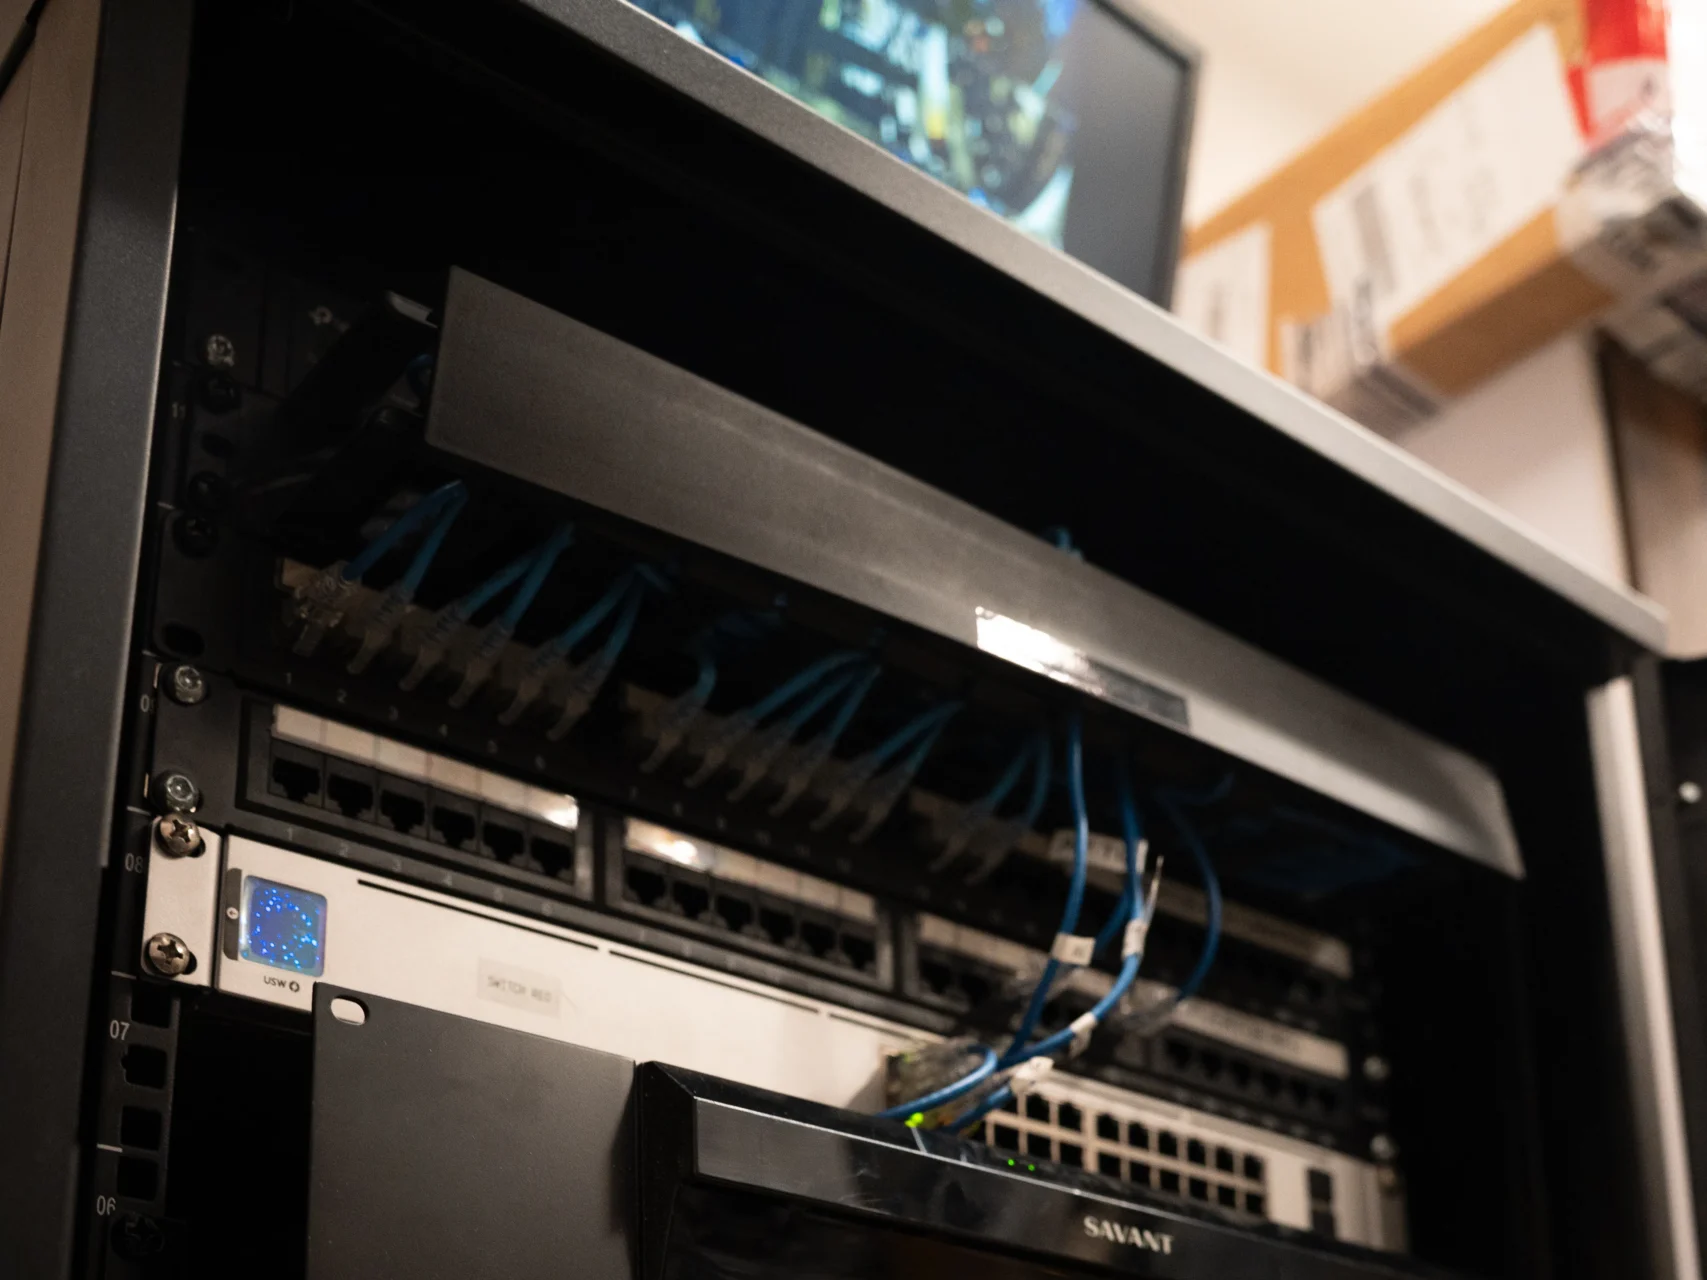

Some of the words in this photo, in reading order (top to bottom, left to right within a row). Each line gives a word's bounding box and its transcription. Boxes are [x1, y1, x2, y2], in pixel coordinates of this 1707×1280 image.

[336, 688, 347, 704] 2
[124, 853, 144, 874] 08
[263, 976, 287, 989] USW
[109, 1019, 131, 1041] 07
[96, 1194, 117, 1216] 06
[1083, 1214, 1174, 1255] SAVANT
